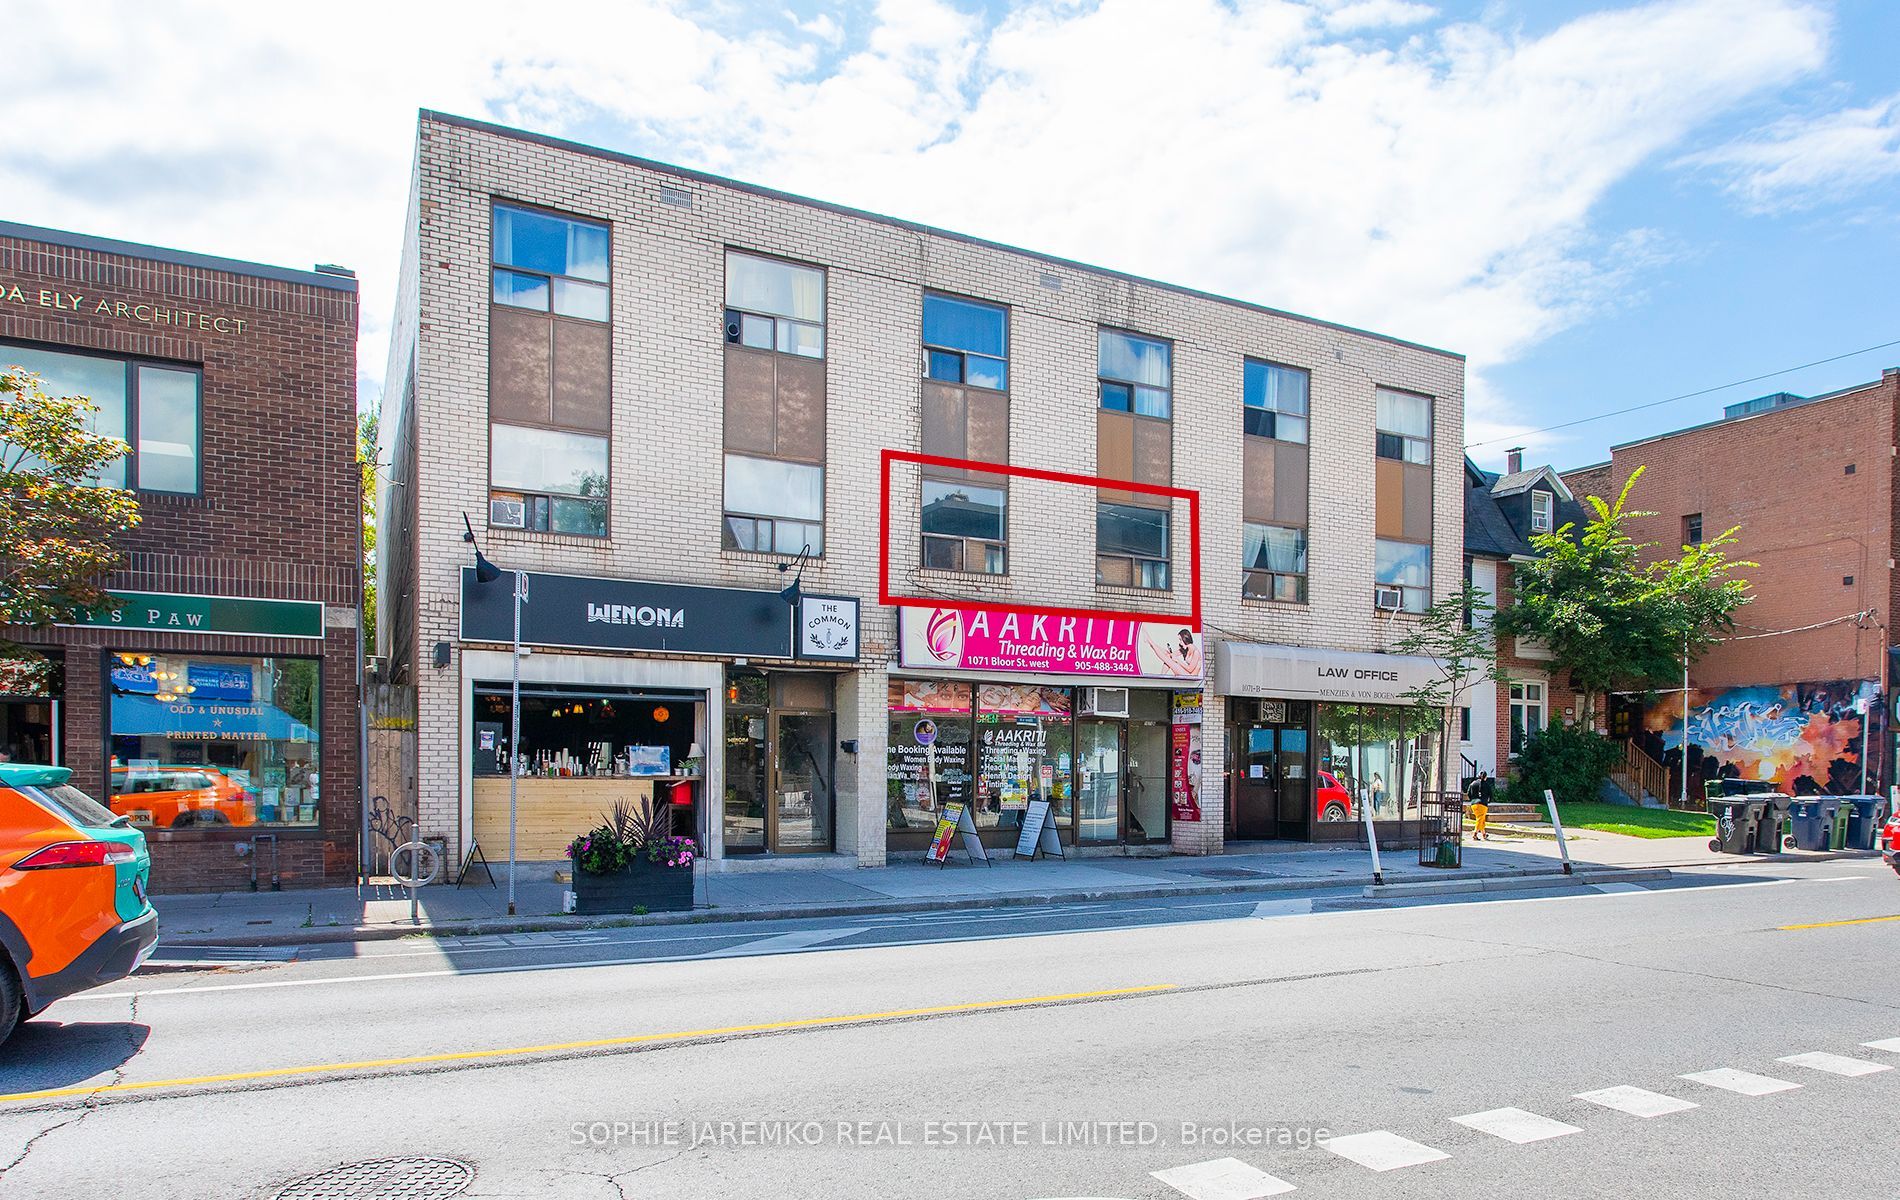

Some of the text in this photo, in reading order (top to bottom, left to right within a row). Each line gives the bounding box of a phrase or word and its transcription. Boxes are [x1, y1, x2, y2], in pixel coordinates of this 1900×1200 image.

[40, 289, 84, 311] ELY
[95, 299, 246, 335] ARCHITECT
[822, 604, 838, 612] THE
[147, 609, 204, 627] PAW
[587, 602, 684, 628] WENONA
[808, 615, 851, 630] COMMON
[999, 639, 1131, 661] Threading & Wax Bar
[967, 656, 1050, 669] 1071 Bloor St. west
[1074, 661, 1135, 673] 905-488-3442
[1317, 667, 1398, 682] LAW OFFICE
[1319, 688, 1350, 697] MENZIES
[1373, 692, 1395, 700] BOGEN
[170, 705, 265, 716] OLD & UNUSUAL
[166, 730, 268, 741] PRINTED MATTER
[995, 729, 1047, 742] AAKRITI
[898, 745, 931, 756] Booking
[933, 745, 967, 755] Available
[985, 746, 1047, 757] Threading Waxing
[944, 757, 965, 765] Waxing
[985, 754, 1007, 763] Facial
[900, 764, 922, 773] Waxing
[985, 763, 1004, 771] Head
